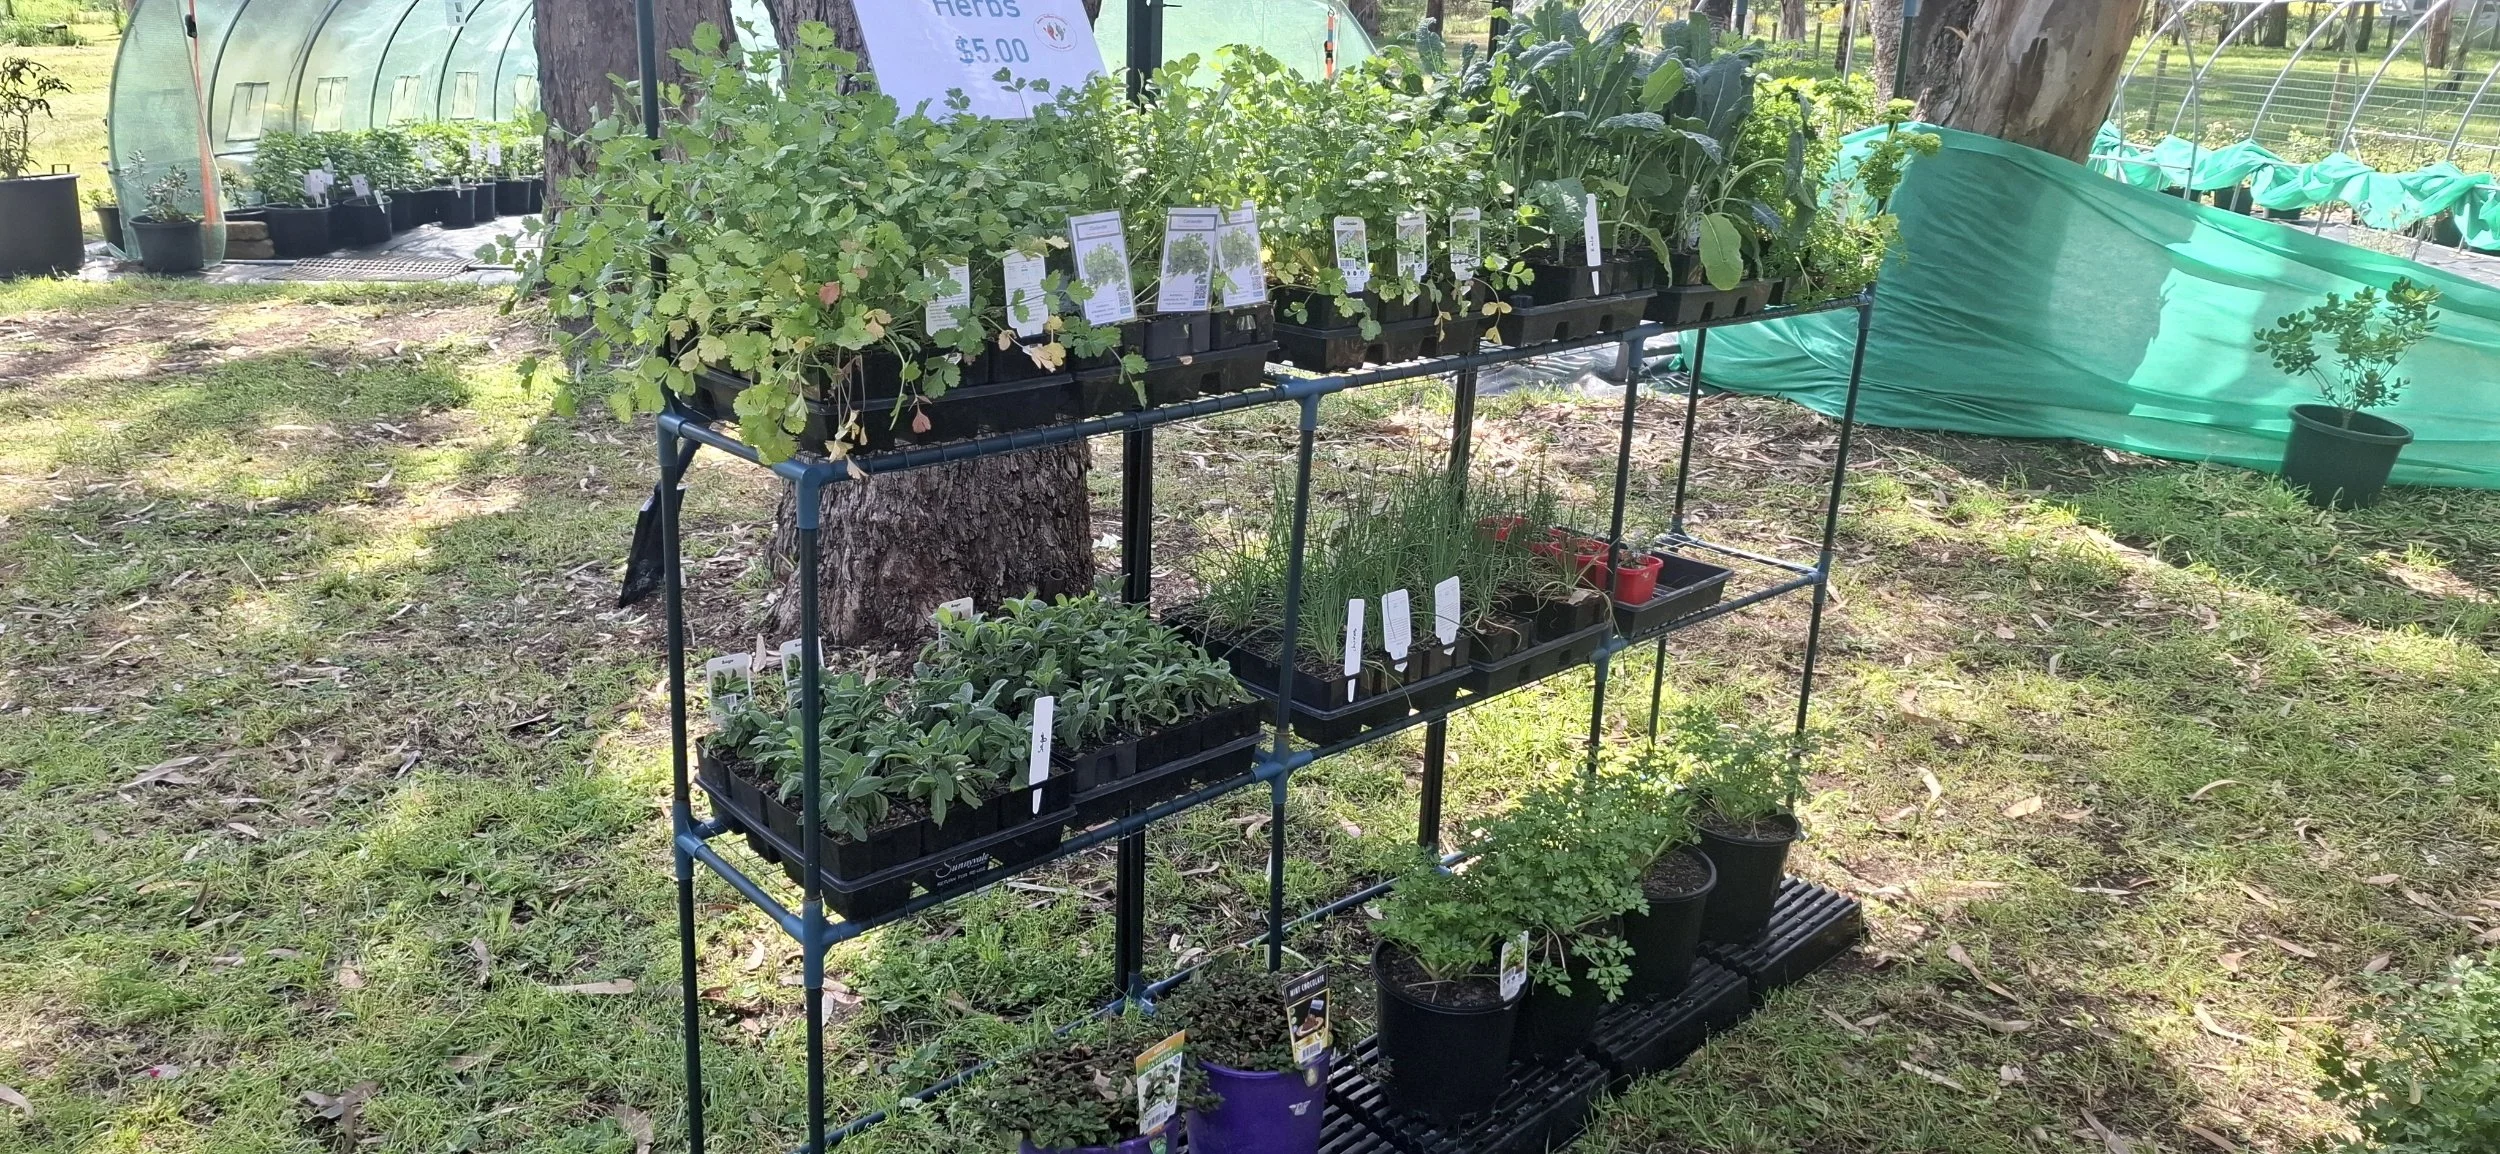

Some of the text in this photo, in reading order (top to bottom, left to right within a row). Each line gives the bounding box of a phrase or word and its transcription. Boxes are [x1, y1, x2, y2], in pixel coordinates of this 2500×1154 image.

[932, 0, 1021, 18] Herbs
[955, 35, 1030, 66] $5.00
[935, 852, 991, 879] Sunnyvale
[957, 872, 968, 880] FOR
[1289, 974, 1325, 997] MINT CHOCOLATE
